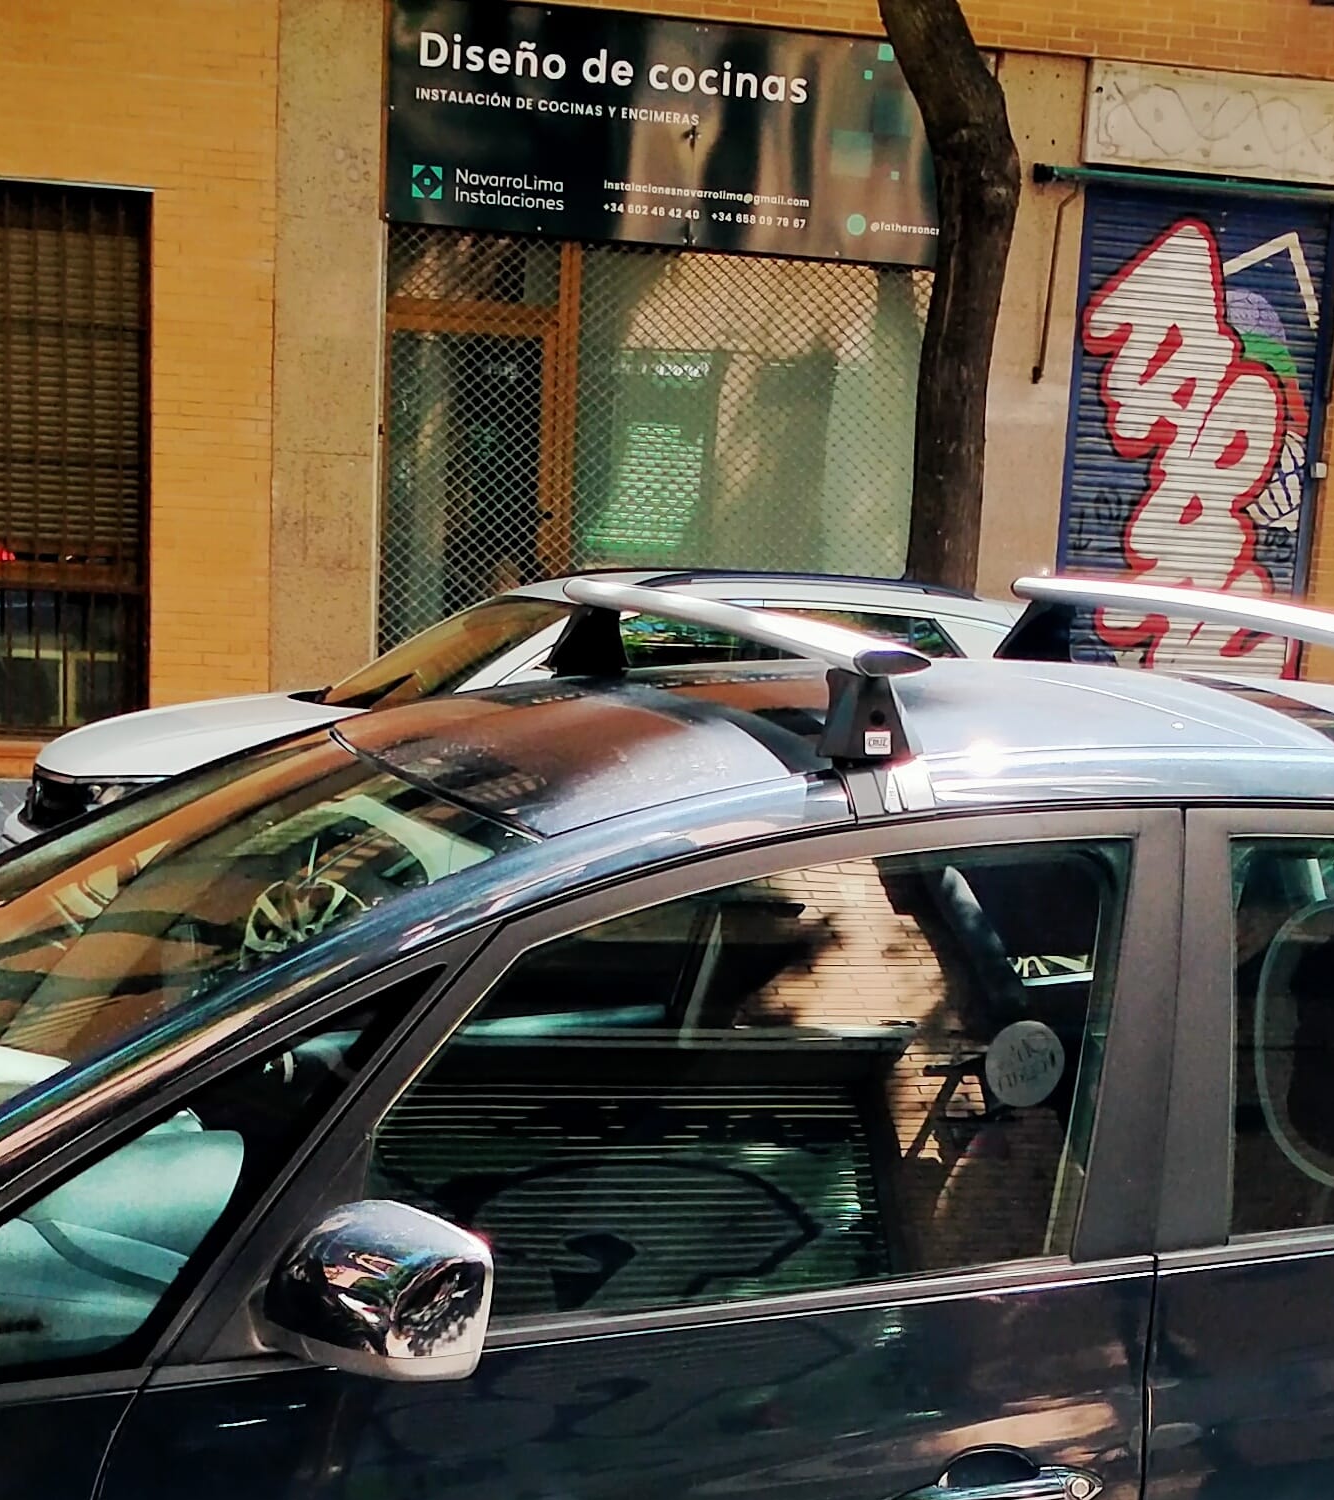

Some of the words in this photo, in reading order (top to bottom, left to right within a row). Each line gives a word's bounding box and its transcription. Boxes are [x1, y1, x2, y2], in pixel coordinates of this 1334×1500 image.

[419, 31, 567, 80] Diseño
[582, 48, 634, 87] de
[648, 61, 809, 104] cocinas
[415, 87, 511, 108] INSTALACIÓN
[516, 97, 533, 110] DE
[537, 99, 603, 117] COCINAS
[608, 106, 617, 118] Y
[621, 108, 700, 125] ENCIMERAS
[455, 167, 564, 192] NavarroLima
[455, 187, 565, 210] Instalaciones
[668, 207, 682, 219] 42
[685, 208, 700, 220] 40
